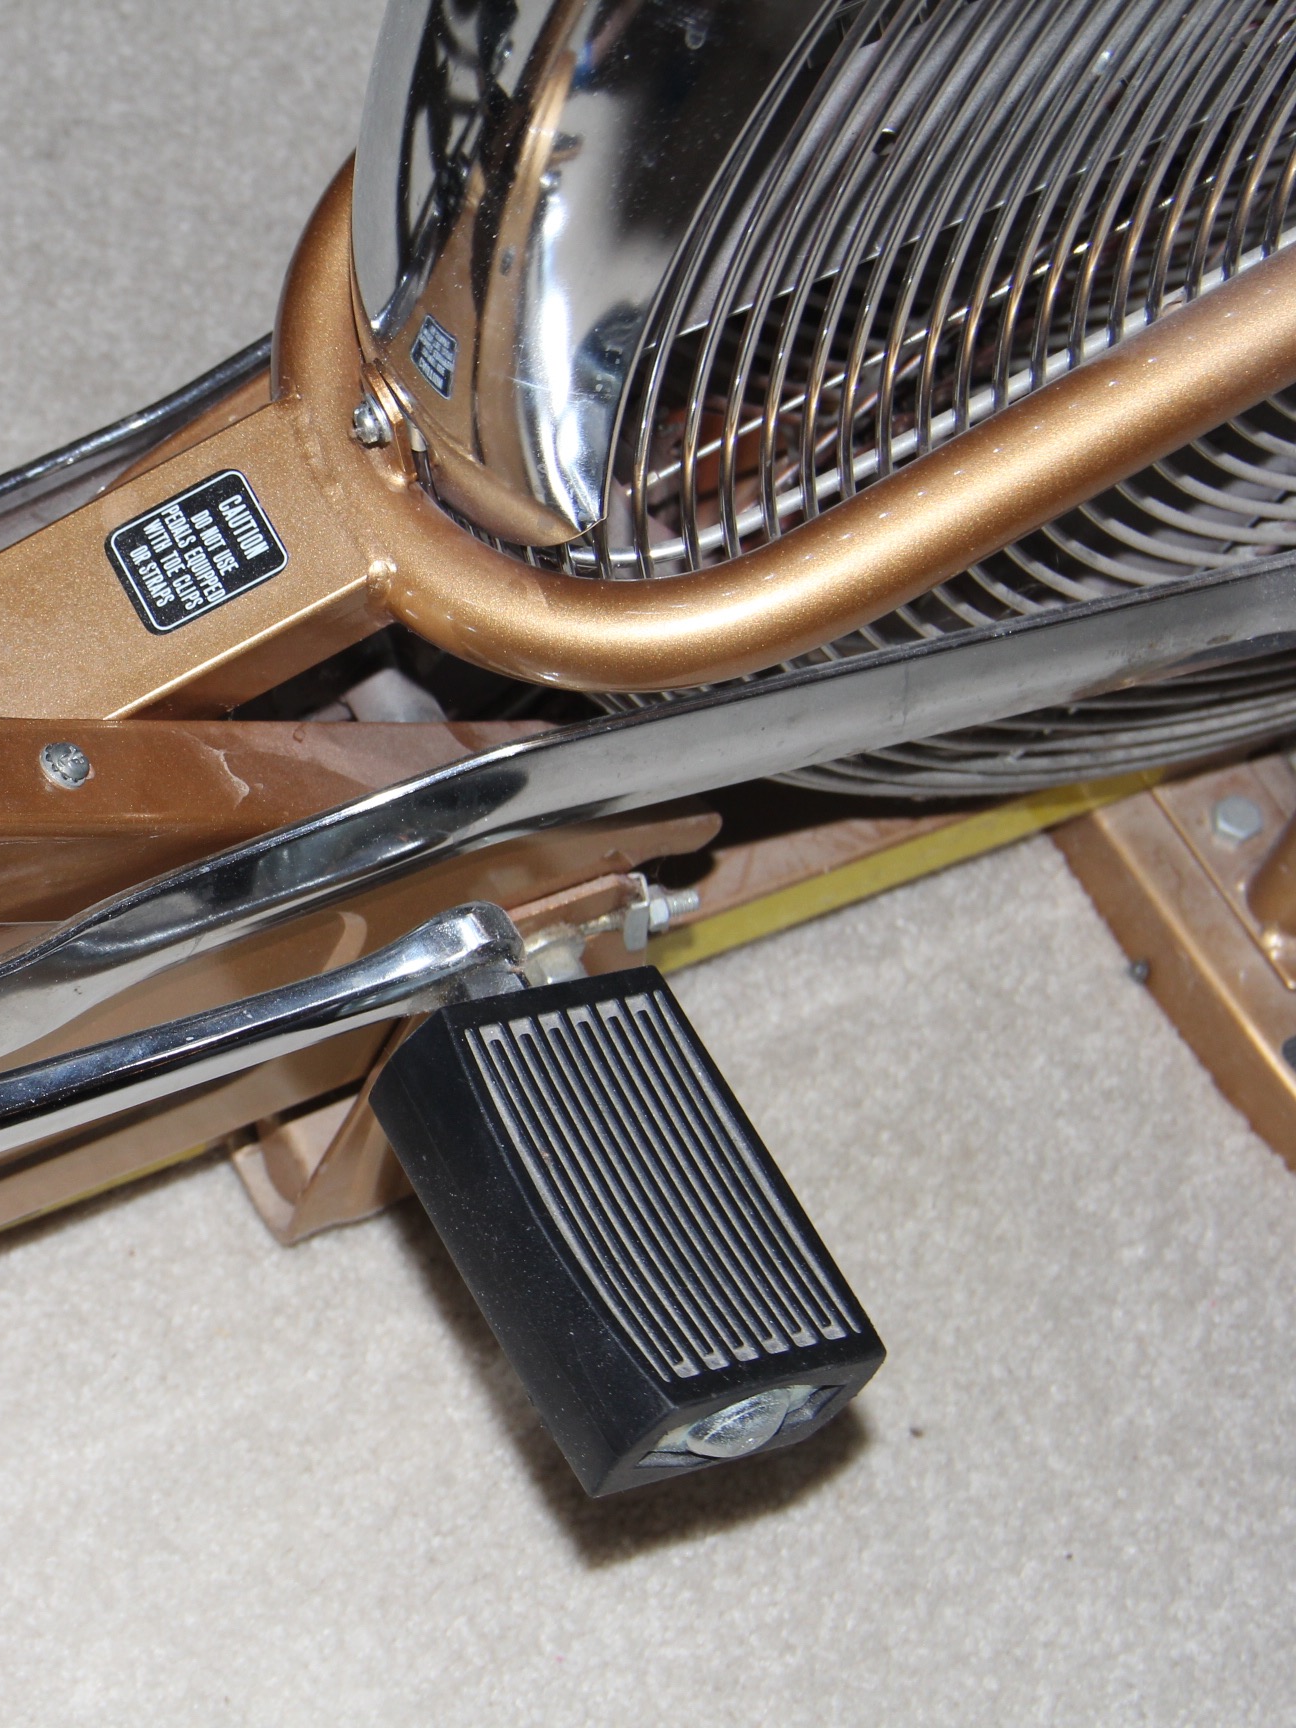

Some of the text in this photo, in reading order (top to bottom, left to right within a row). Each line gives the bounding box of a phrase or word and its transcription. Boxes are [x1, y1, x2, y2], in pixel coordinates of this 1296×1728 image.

[161, 504, 227, 603] PEDALS EQUIPPED
[191, 509, 239, 576] DO NOT USE
[218, 494, 269, 560] CAUTION
[129, 545, 175, 607] OR STRAPS
[143, 518, 203, 610] WITH TOE CLIPS
